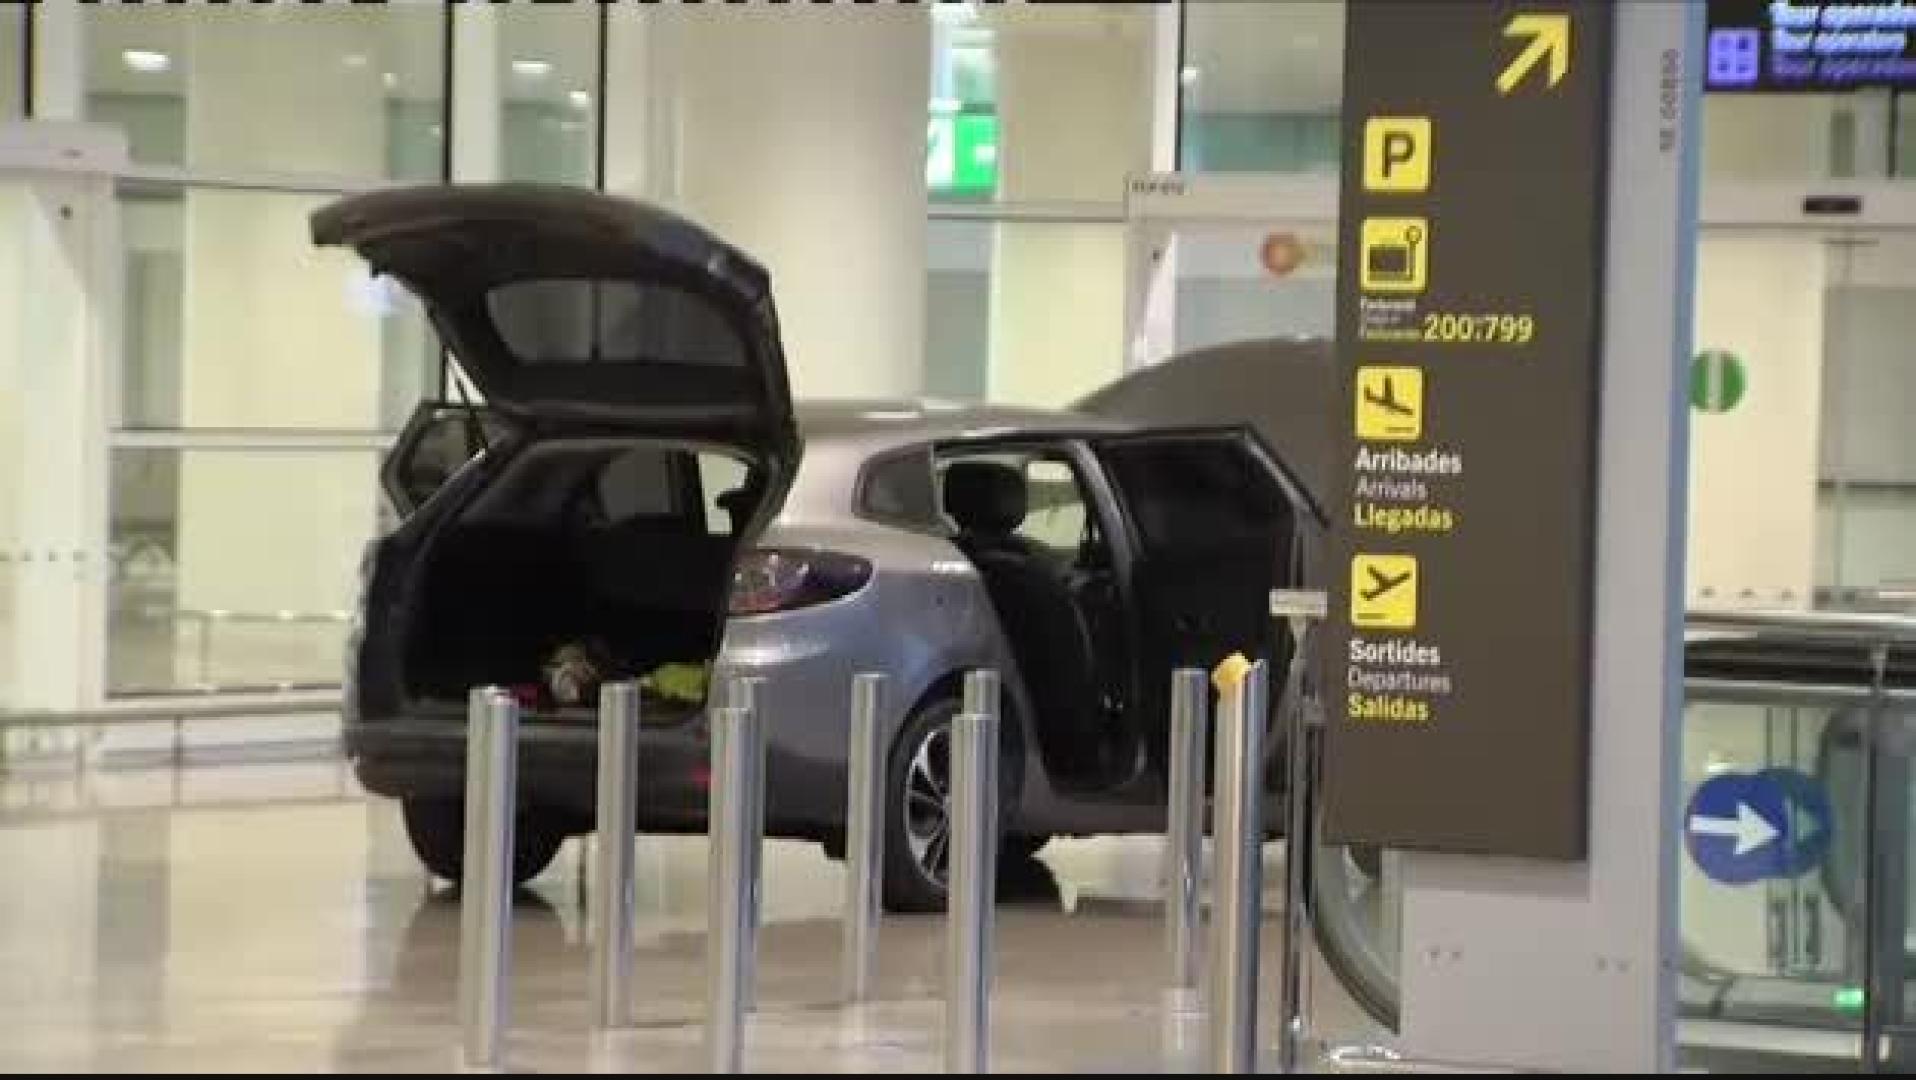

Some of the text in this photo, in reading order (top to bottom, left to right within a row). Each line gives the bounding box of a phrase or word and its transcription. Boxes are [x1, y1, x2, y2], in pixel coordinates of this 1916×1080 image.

[1382, 130, 1414, 178] P
[1354, 446, 1462, 473] Arribades
[1356, 477, 1426, 499] Arrivals
[1354, 502, 1453, 533] Llegadas
[1349, 638, 1440, 664] Sortides
[1348, 666, 1451, 692] Departures
[1348, 693, 1429, 720] Salidas
